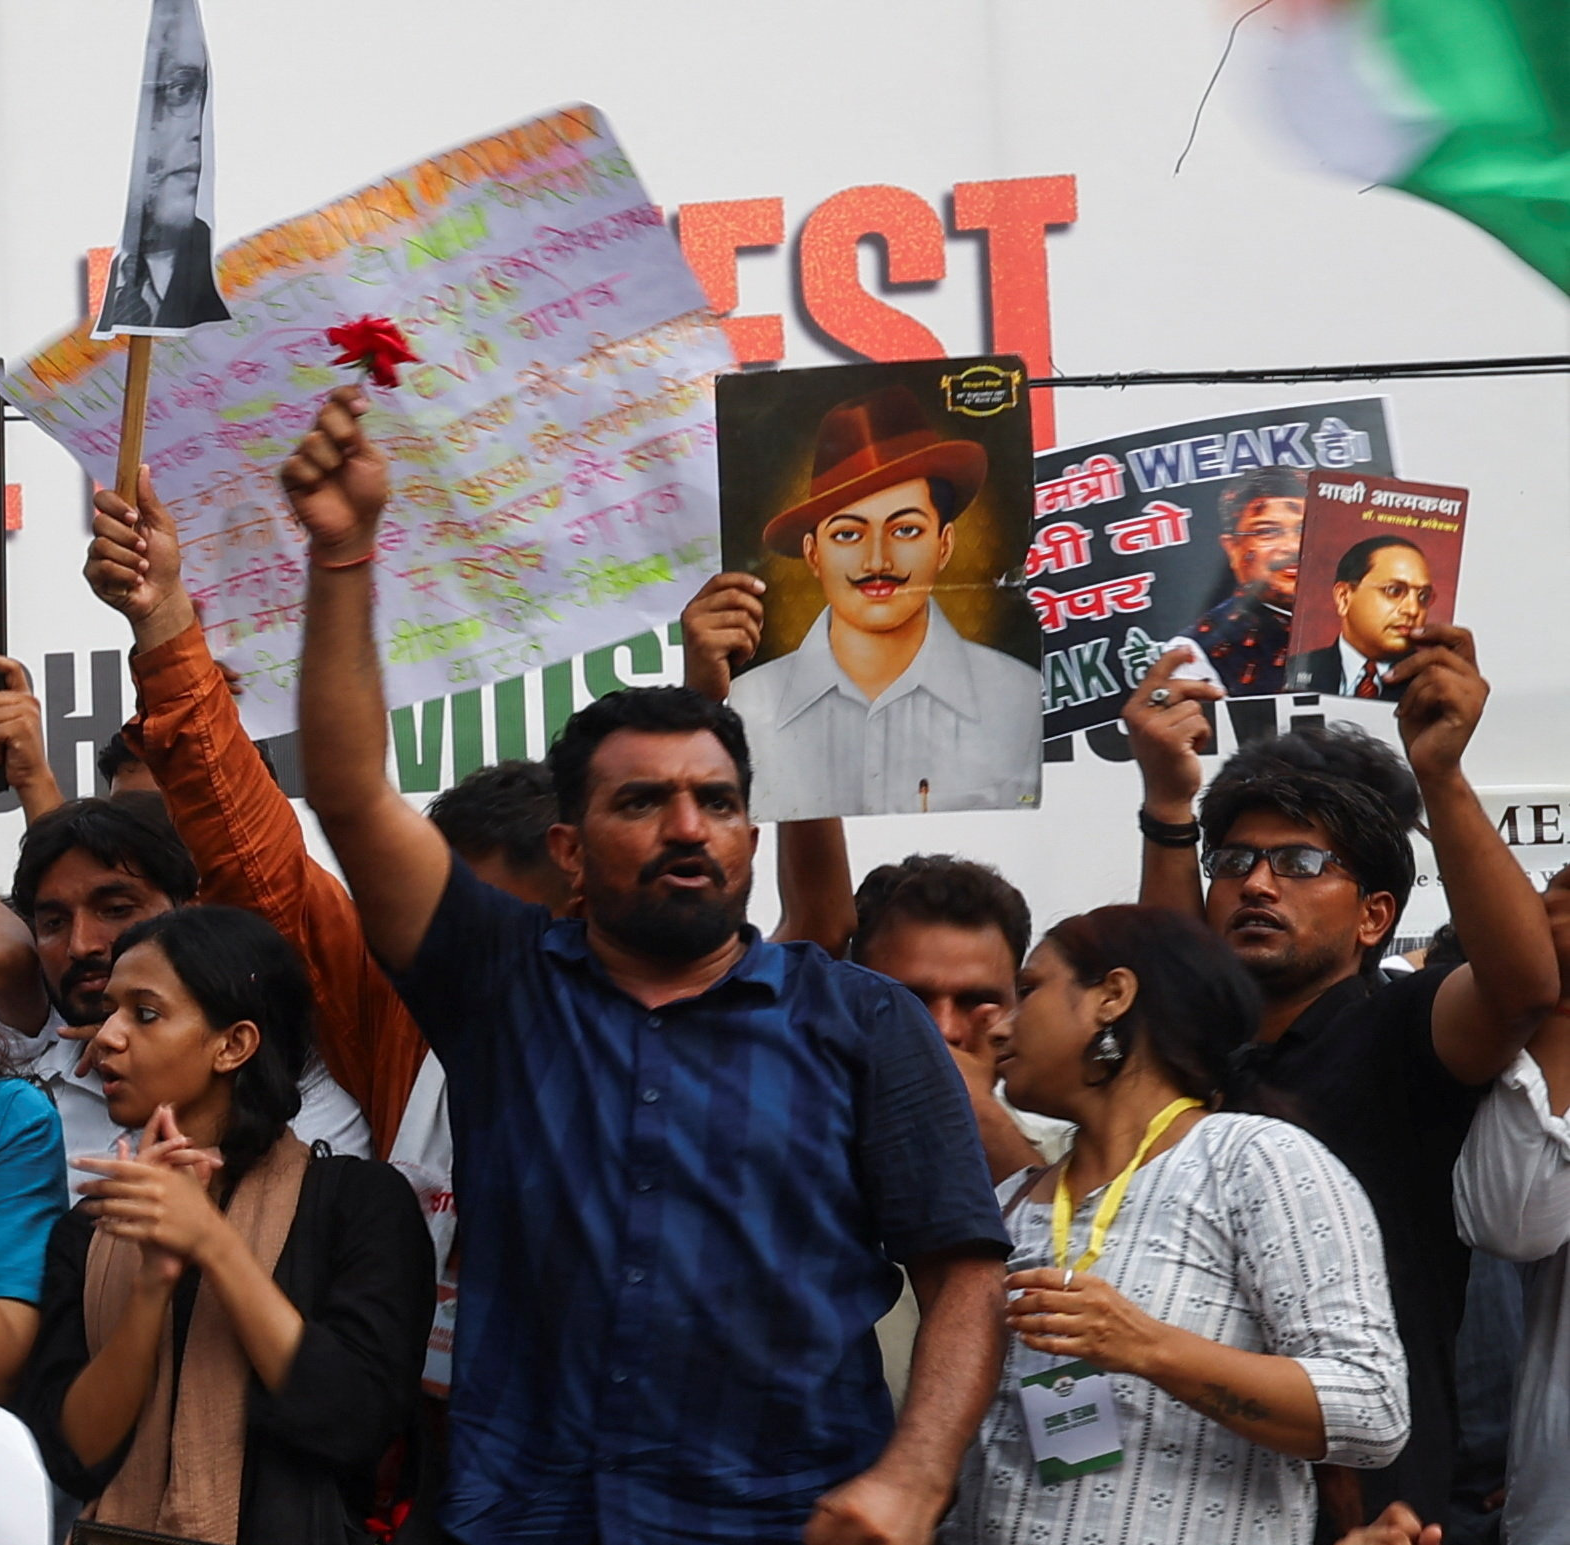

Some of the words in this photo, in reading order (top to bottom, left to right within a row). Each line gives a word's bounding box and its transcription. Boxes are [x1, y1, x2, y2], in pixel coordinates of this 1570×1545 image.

[1126, 421, 1315, 493] WEAK
[1105, 500, 1191, 555] तो
[1318, 481, 1366, 505] माझी
[1371, 489, 1462, 517] आत्मकथा
[1041, 637, 1121, 714] AK
